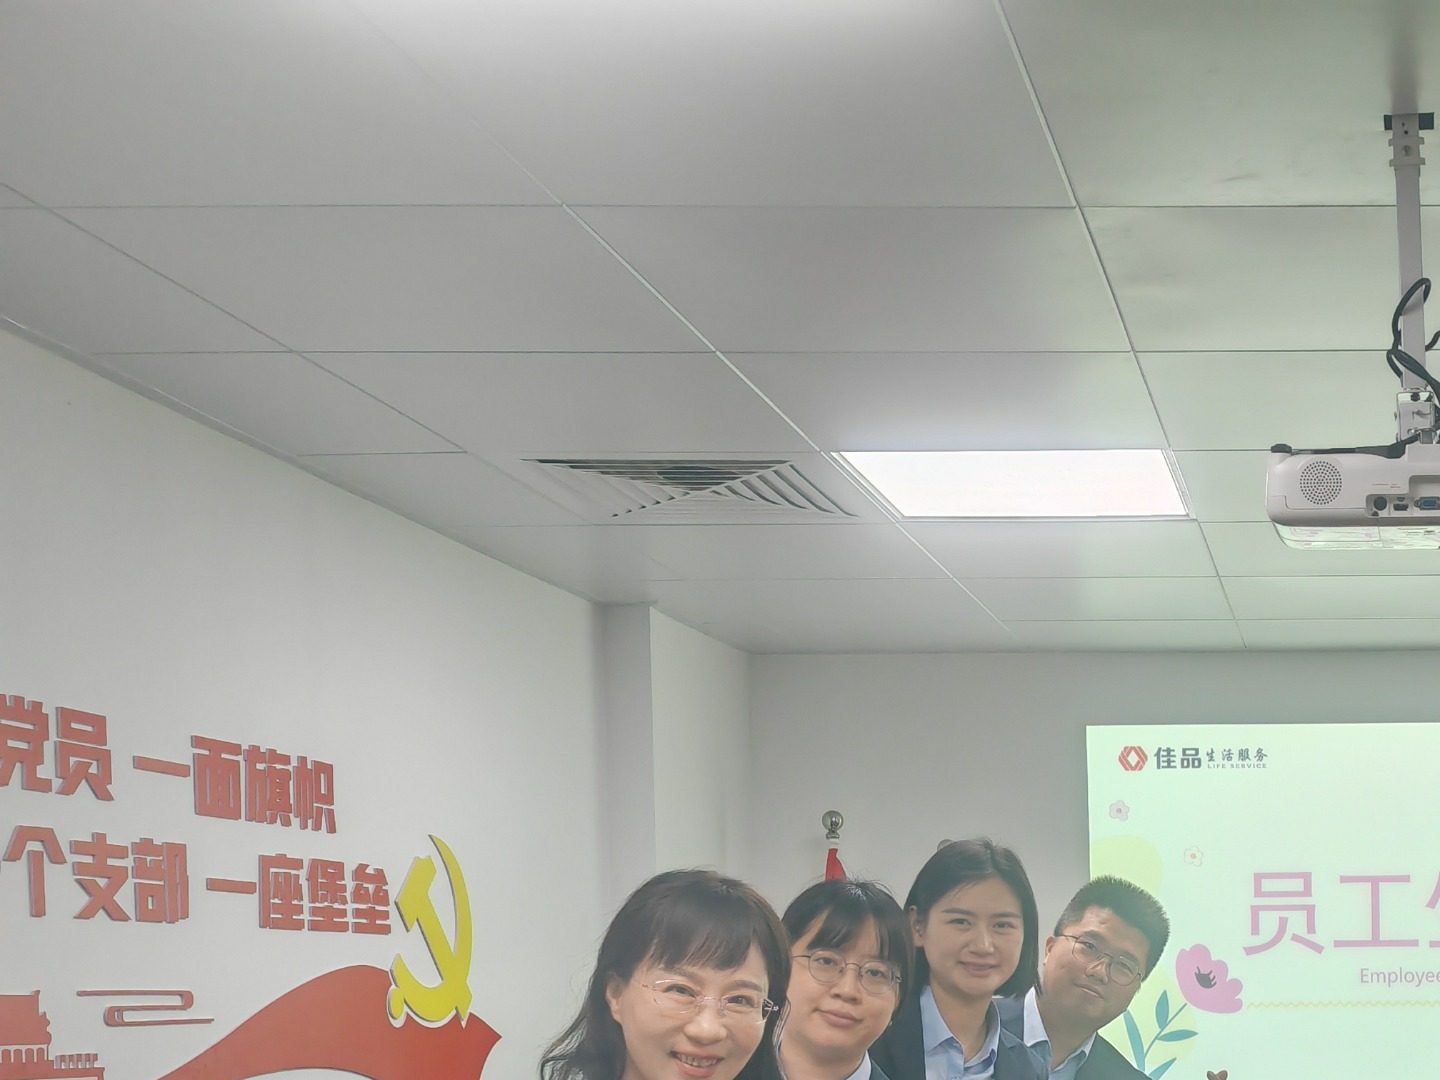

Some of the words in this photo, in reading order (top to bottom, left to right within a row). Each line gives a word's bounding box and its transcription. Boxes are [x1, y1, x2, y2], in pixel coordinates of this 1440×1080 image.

[0, 693, 114, 801] 党员
[133, 735, 336, 834] 一面旗帜
[1154, 746, 1202, 769] 佳品
[1206, 747, 1268, 762] 生活服务
[206, 853, 391, 935] 一座堡垒
